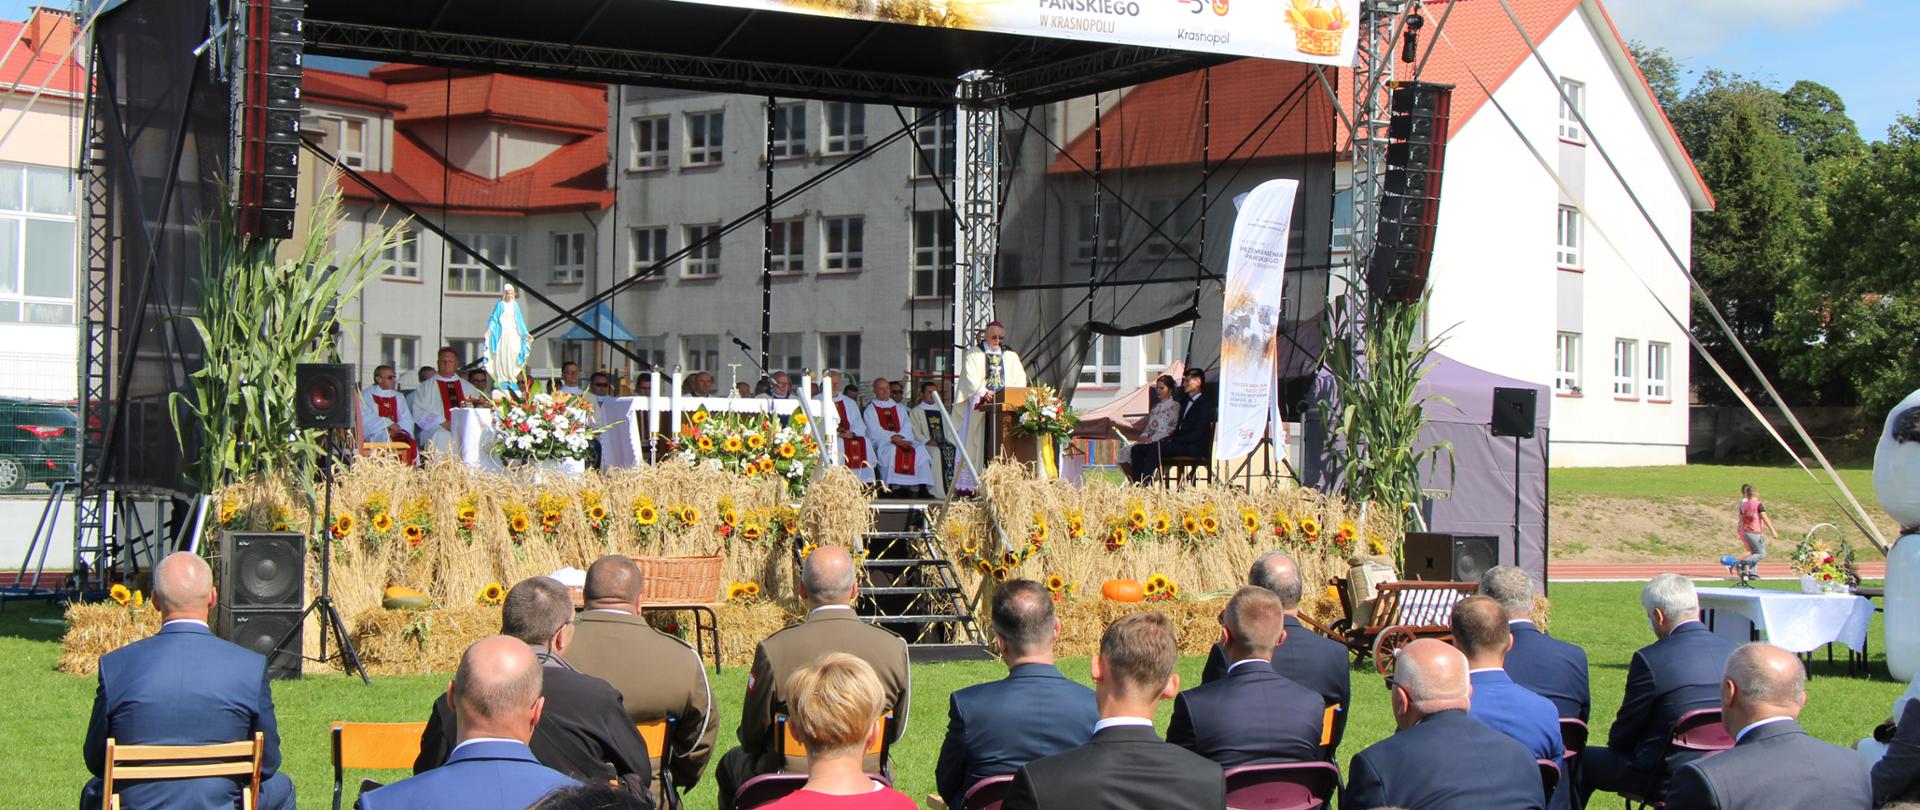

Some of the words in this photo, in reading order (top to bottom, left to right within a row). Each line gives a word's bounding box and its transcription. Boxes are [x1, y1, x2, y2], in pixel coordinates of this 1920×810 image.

[1040, 14, 1049, 27] W
[1051, 15, 1115, 34] KRASNOPOLU
[1177, 28, 1230, 46] Krasnopol
